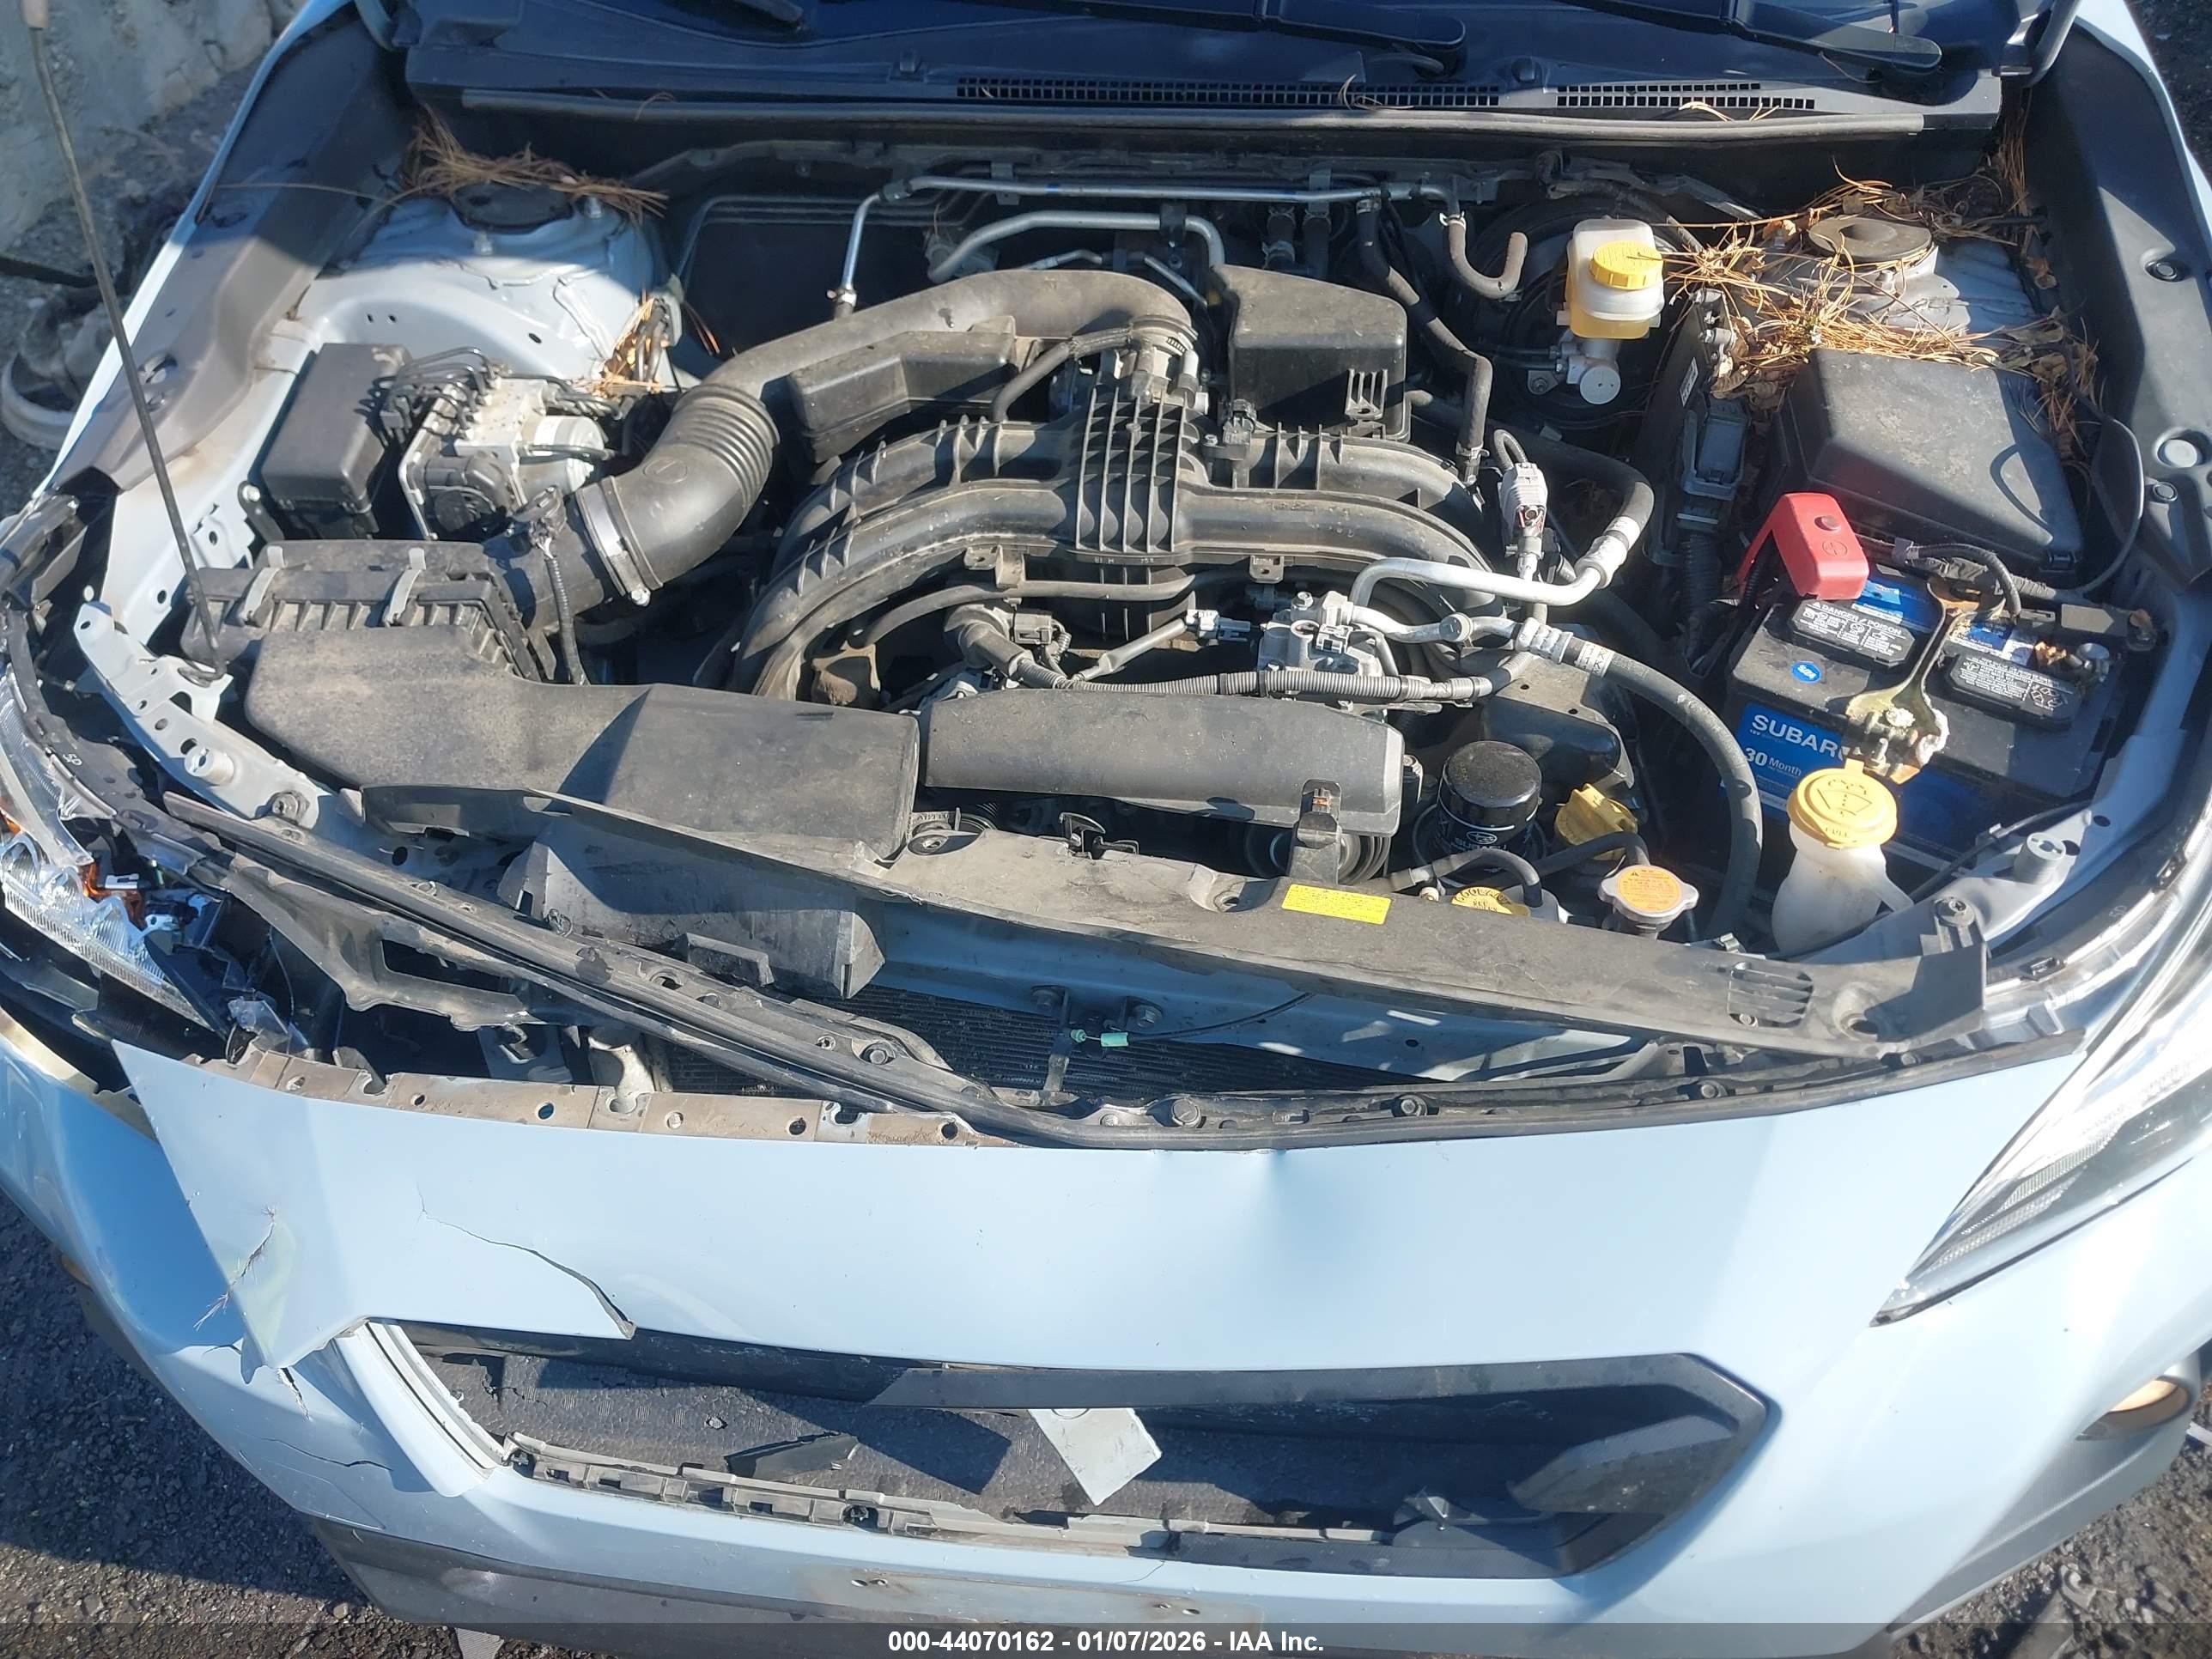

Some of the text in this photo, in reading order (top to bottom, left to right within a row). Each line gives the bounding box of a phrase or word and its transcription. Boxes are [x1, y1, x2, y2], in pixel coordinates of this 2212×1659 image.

[1821, 605, 1859, 623] DANGER
[1867, 619, 1902, 635] POISON
[1768, 756, 1802, 777] Month
